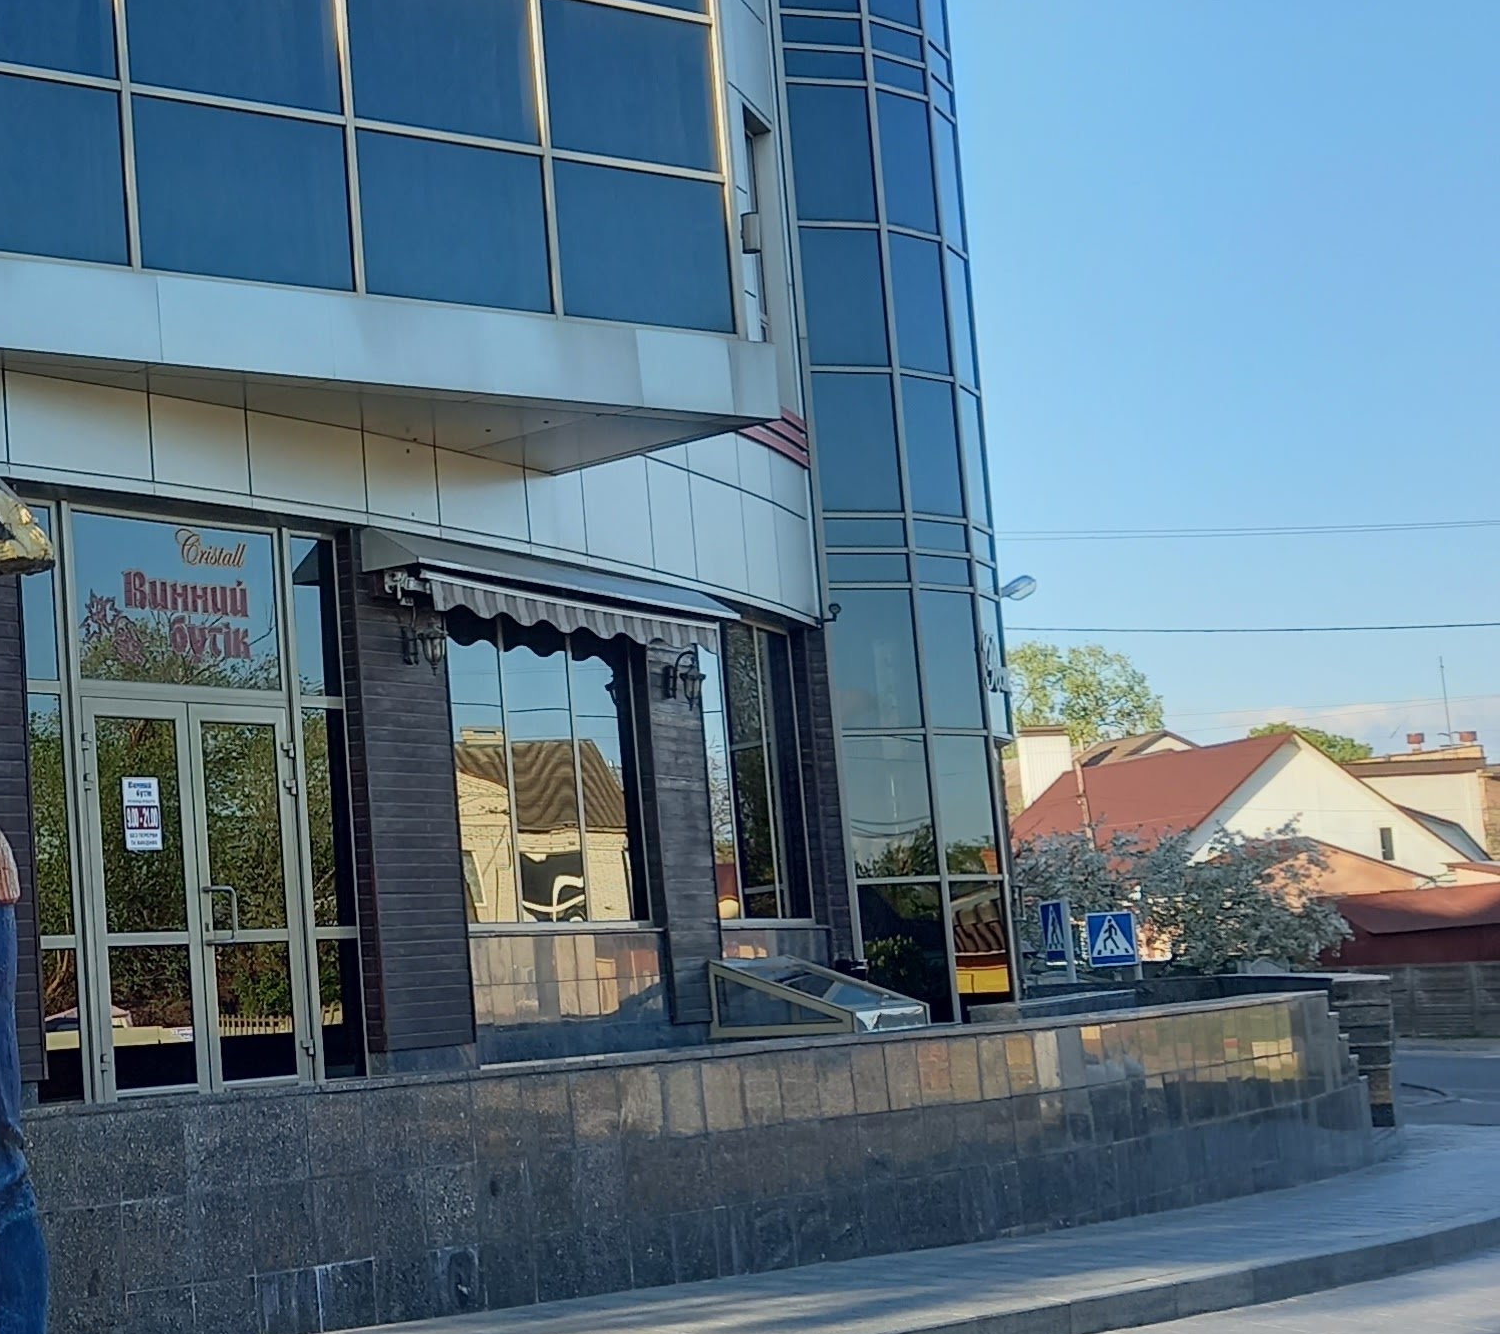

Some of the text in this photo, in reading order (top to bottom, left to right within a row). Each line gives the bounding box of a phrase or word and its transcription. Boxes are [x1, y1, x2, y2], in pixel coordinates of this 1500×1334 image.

[175, 528, 247, 568] Cristall
[122, 570, 249, 618] Винний
[169, 614, 251, 665] бутік
